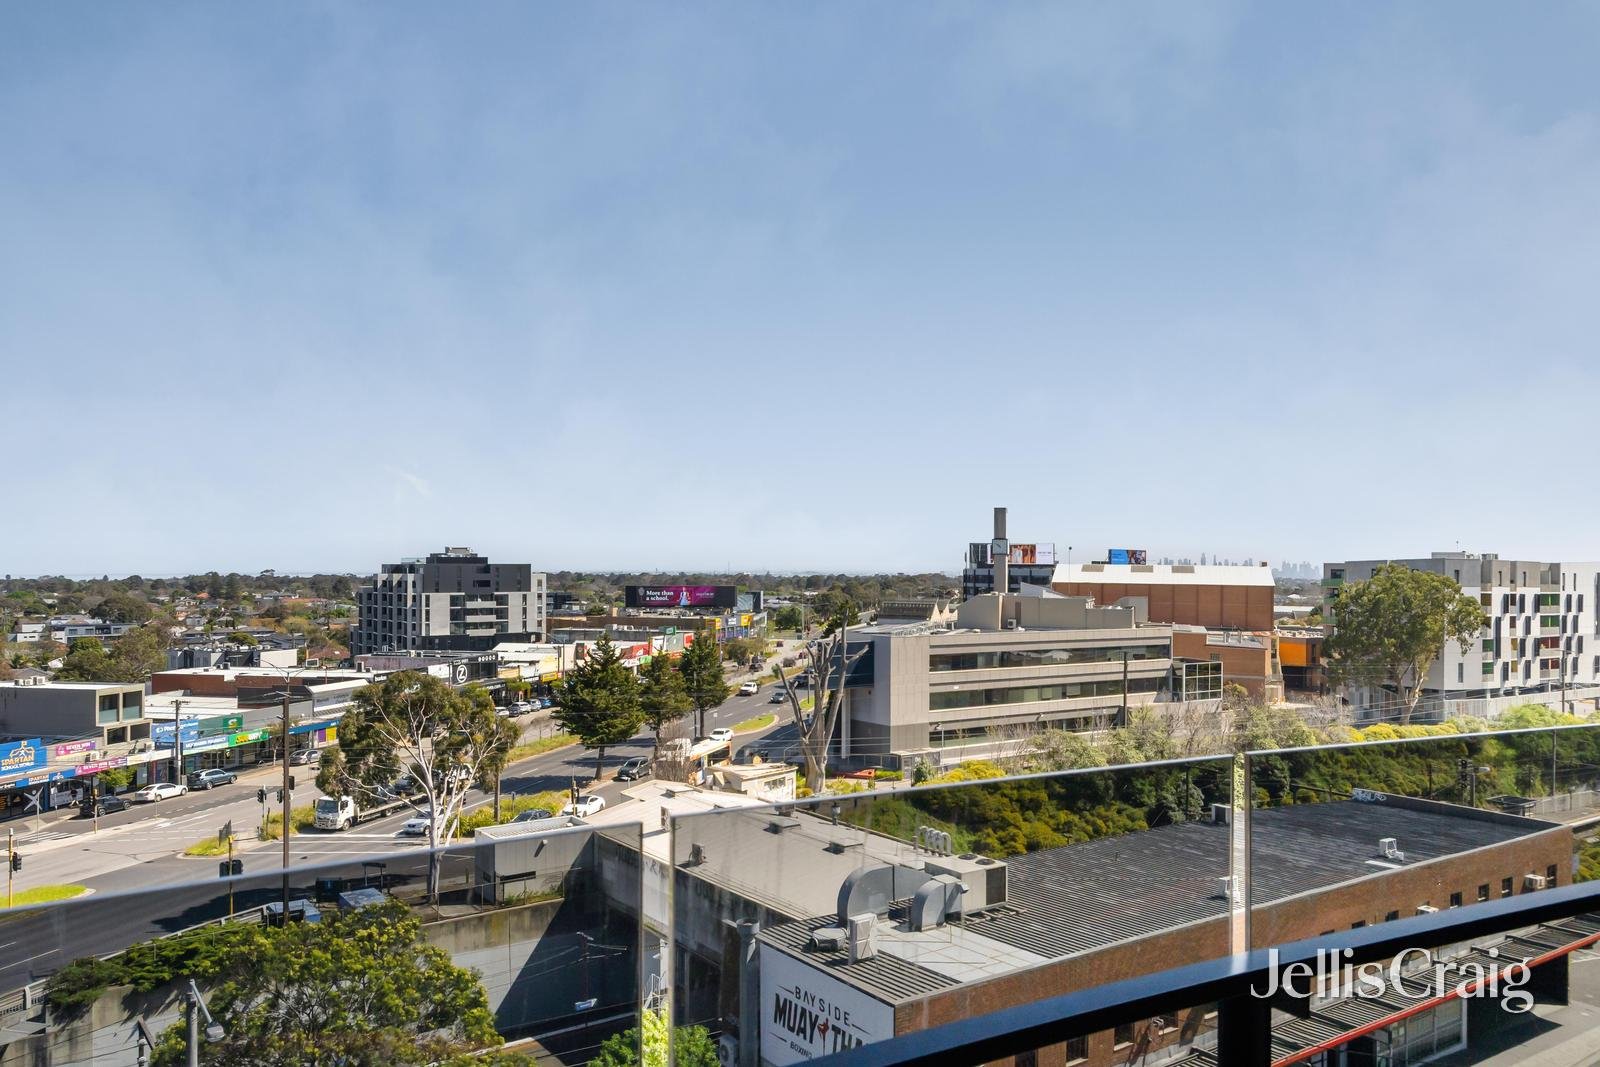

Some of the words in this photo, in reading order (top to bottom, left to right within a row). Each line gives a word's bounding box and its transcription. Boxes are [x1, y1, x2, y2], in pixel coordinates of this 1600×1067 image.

[236, 731, 263, 745] SUBWAY
[1, 755, 33, 767] SPARTAN
[774, 993, 819, 1044] MUAY
[795, 986, 850, 1027] BAYSIDE
